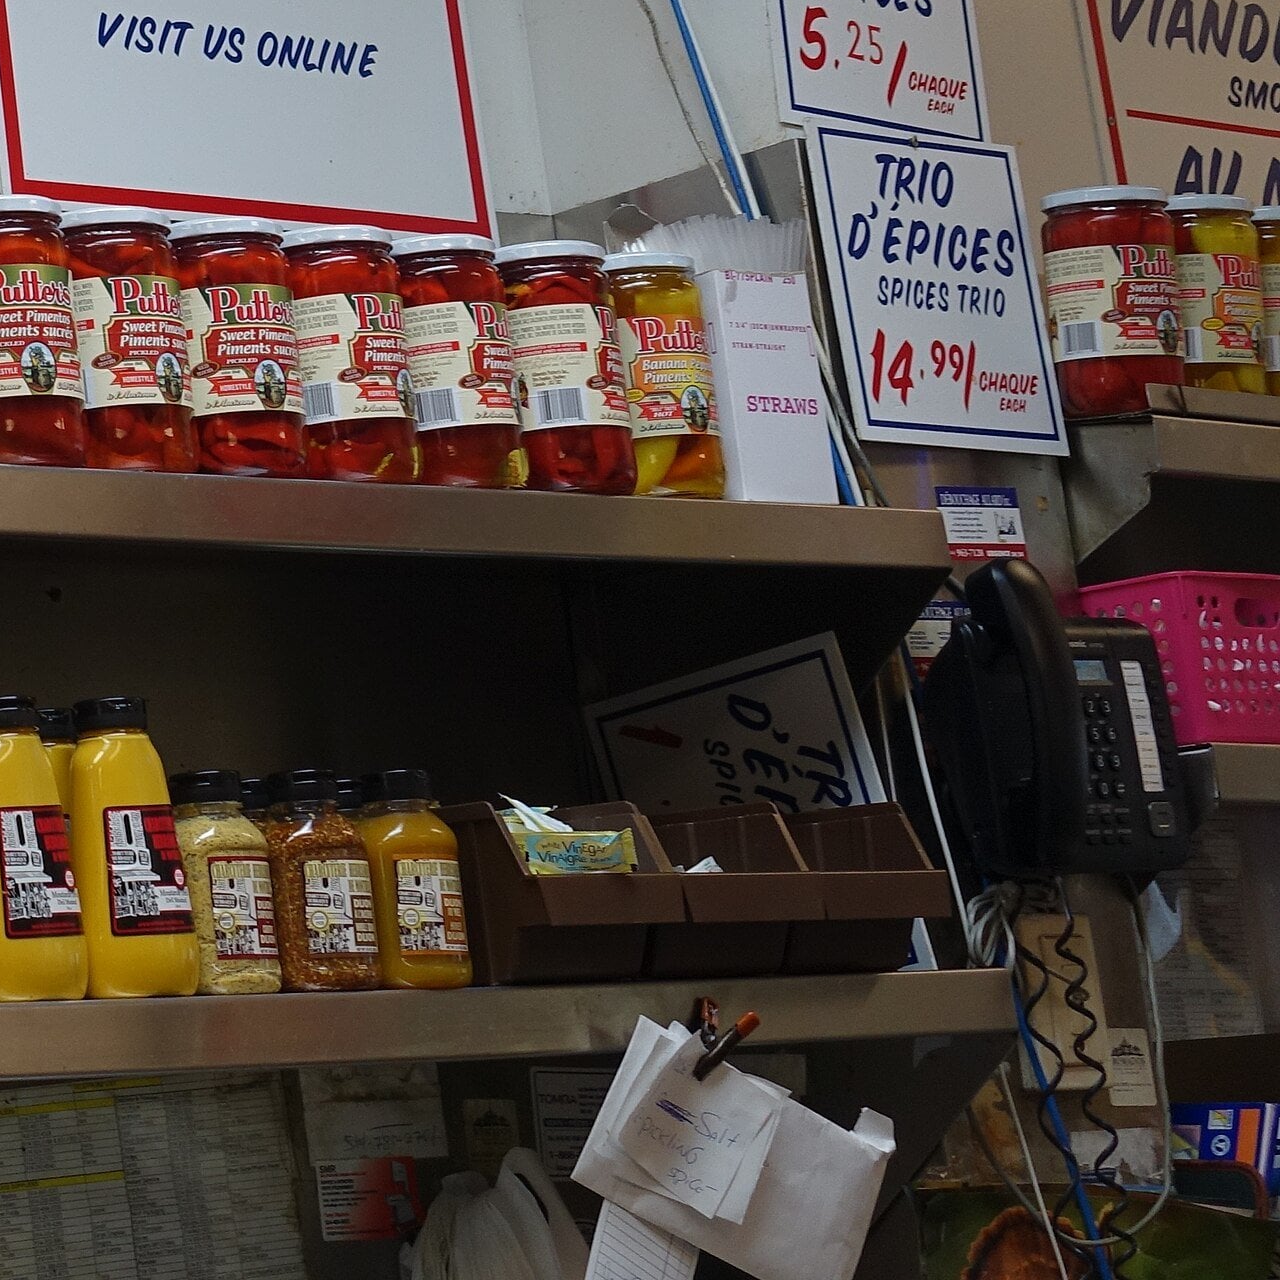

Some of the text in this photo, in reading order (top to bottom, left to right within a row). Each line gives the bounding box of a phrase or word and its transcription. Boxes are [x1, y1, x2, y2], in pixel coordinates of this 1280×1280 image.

[97, 12, 379, 78] VISIT US ONLINE
[908, 71, 968, 101] CHAQUE
[928, 98, 955, 115] EACH
[875, 153, 953, 209] TRIO
[847, 201, 1015, 278] D'ÉPICES
[1128, 283, 1159, 293] Sweet
[877, 279, 1005, 318] SPICES TRIO
[1126, 294, 1170, 305] Piments
[25, 310, 71, 325] Pimentos
[43, 326, 73, 340] sucrés
[642, 359, 688, 371] Banana
[643, 372, 692, 385] Piments
[979, 370, 1038, 396] CHAQUE
[746, 395, 819, 416] STRAWS
[1000, 394, 1026, 413] EACH
